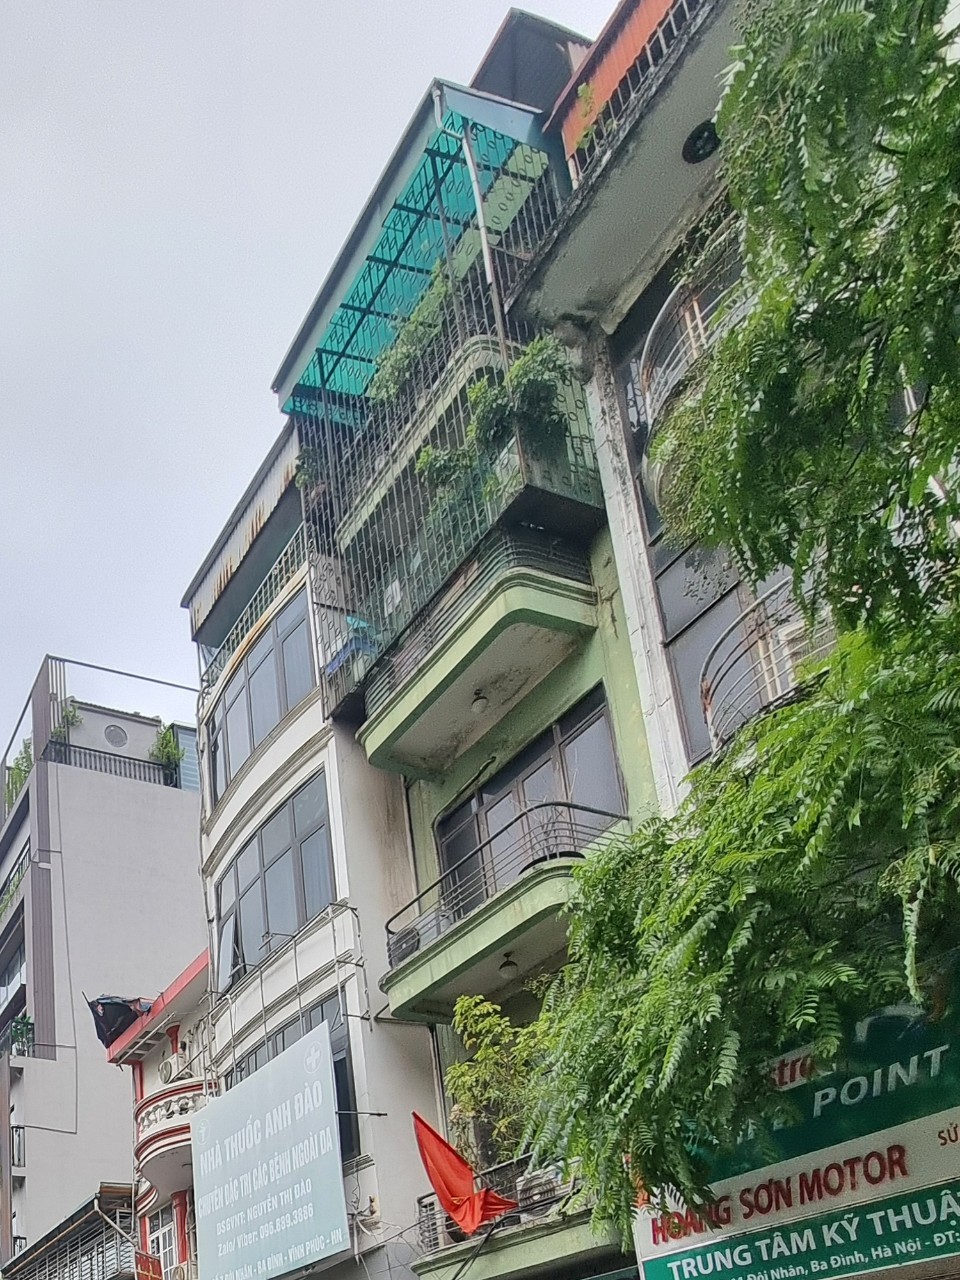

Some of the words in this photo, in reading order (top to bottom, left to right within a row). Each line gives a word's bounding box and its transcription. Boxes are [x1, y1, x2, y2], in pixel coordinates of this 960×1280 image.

[813, 1044, 950, 1118] POINT
[200, 1140, 222, 1176] NHÀ
[224, 1114, 261, 1162] THUỐC
[265, 1100, 291, 1139] ANH
[294, 1080, 322, 1120] ĐÀO
[253, 1161, 268, 1190] CÁC
[268, 1149, 291, 1185] BỆNH
[292, 1132, 319, 1170] NGOÀI
[320, 1126, 333, 1155] DA
[937, 1122, 960, 1146] SỬ
[294, 1178, 312, 1199] ĐÀO
[740, 1175, 793, 1219] SƠN
[799, 1144, 908, 1205] MOTOR
[306, 1234, 325, 1256] PHÚC
[667, 1245, 752, 1280] TRUNG
[755, 1228, 817, 1261] TÂM
[822, 1213, 860, 1247] KỸ
[866, 1189, 960, 1236] THUẬ
[771, 1263, 809, 1280] Nhân,
[810, 1260, 828, 1273] Ba
[830, 1252, 869, 1268] Đình,
[871, 1245, 892, 1260] Hà
[894, 1238, 921, 1255] Nội
